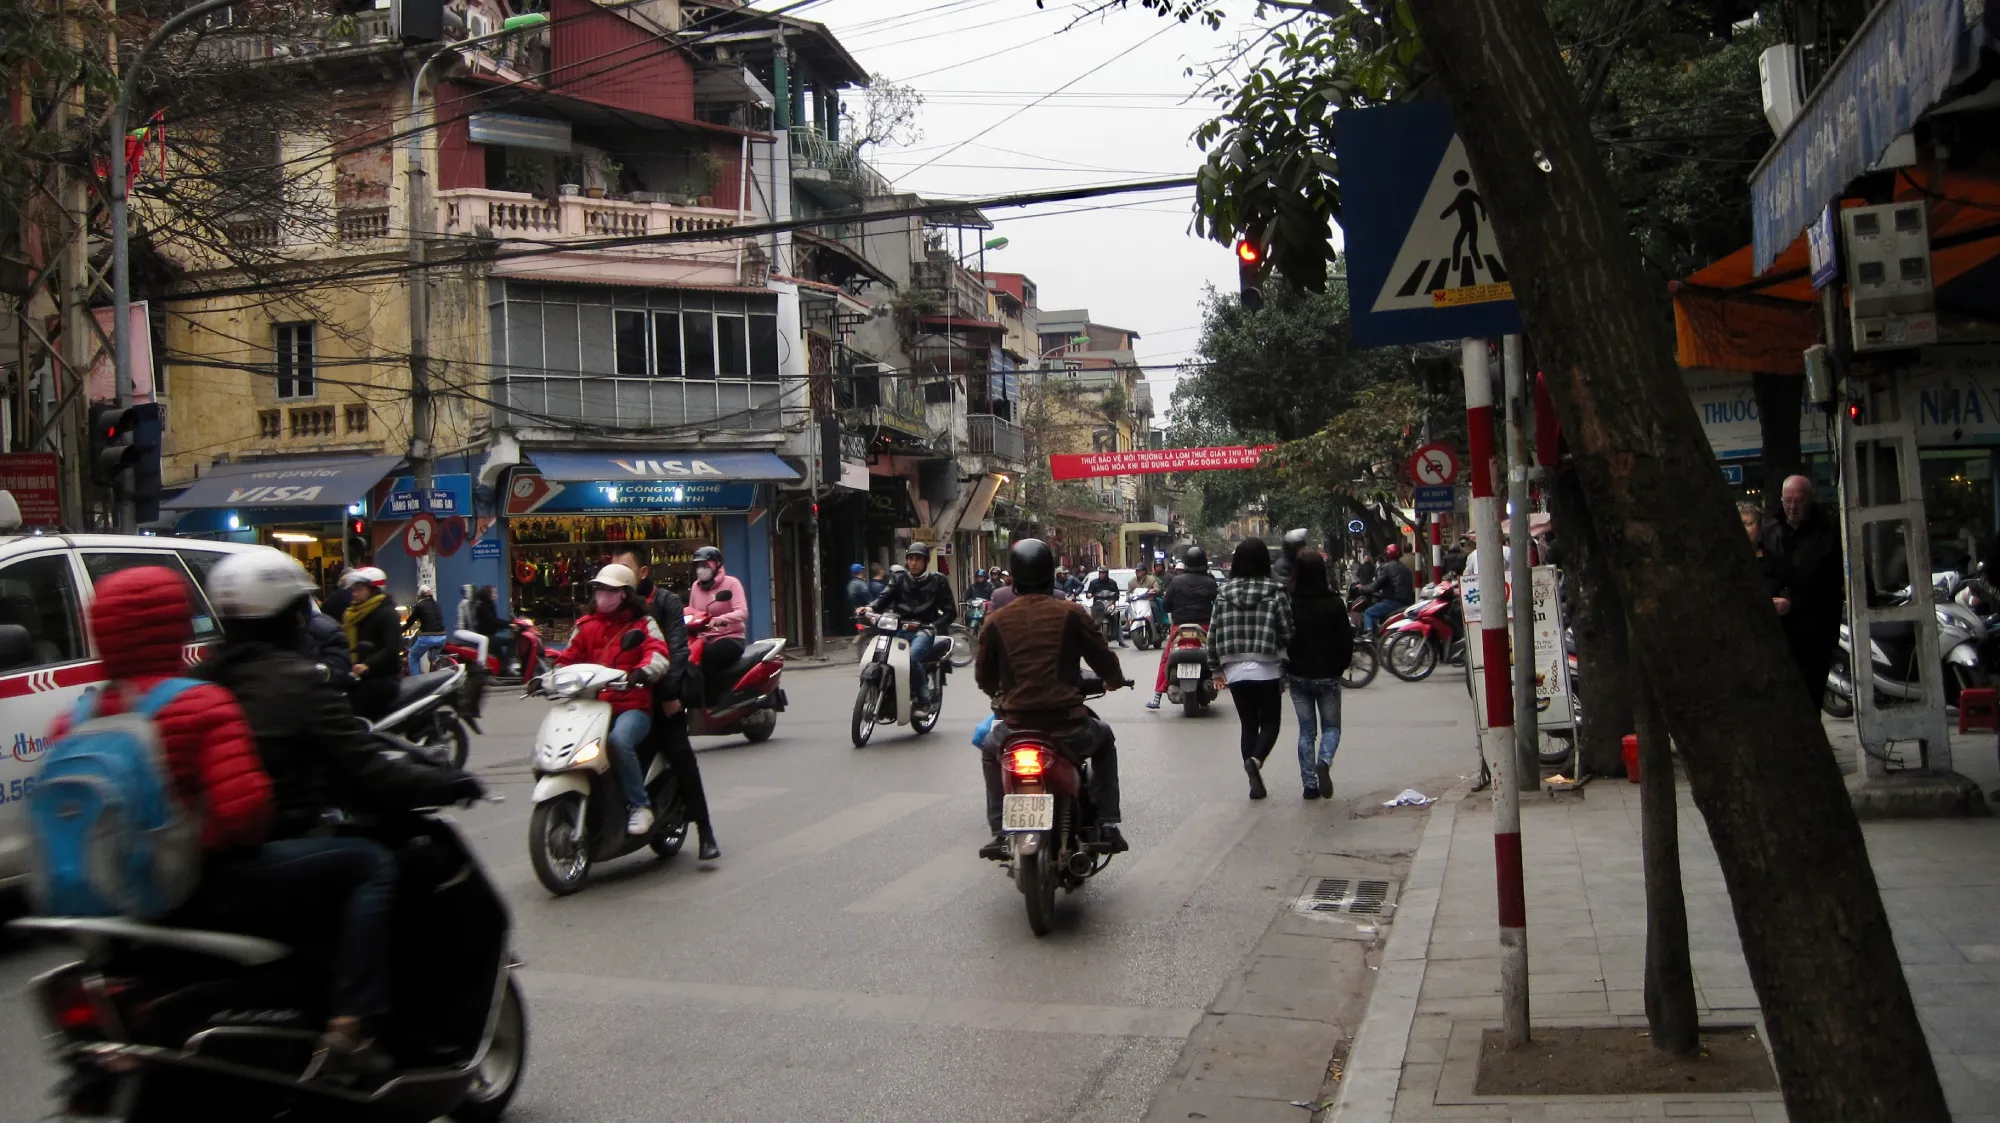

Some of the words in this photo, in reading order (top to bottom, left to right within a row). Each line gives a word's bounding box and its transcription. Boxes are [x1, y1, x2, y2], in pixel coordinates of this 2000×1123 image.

[608, 460, 724, 475] VISA
[1127, 461, 1139, 470] KHI
[251, 471, 277, 479] we
[278, 469, 342, 480] prefer
[625, 484, 662, 493] CÔNG
[226, 485, 325, 503] VISA
[638, 494, 683, 503] TRÀN
